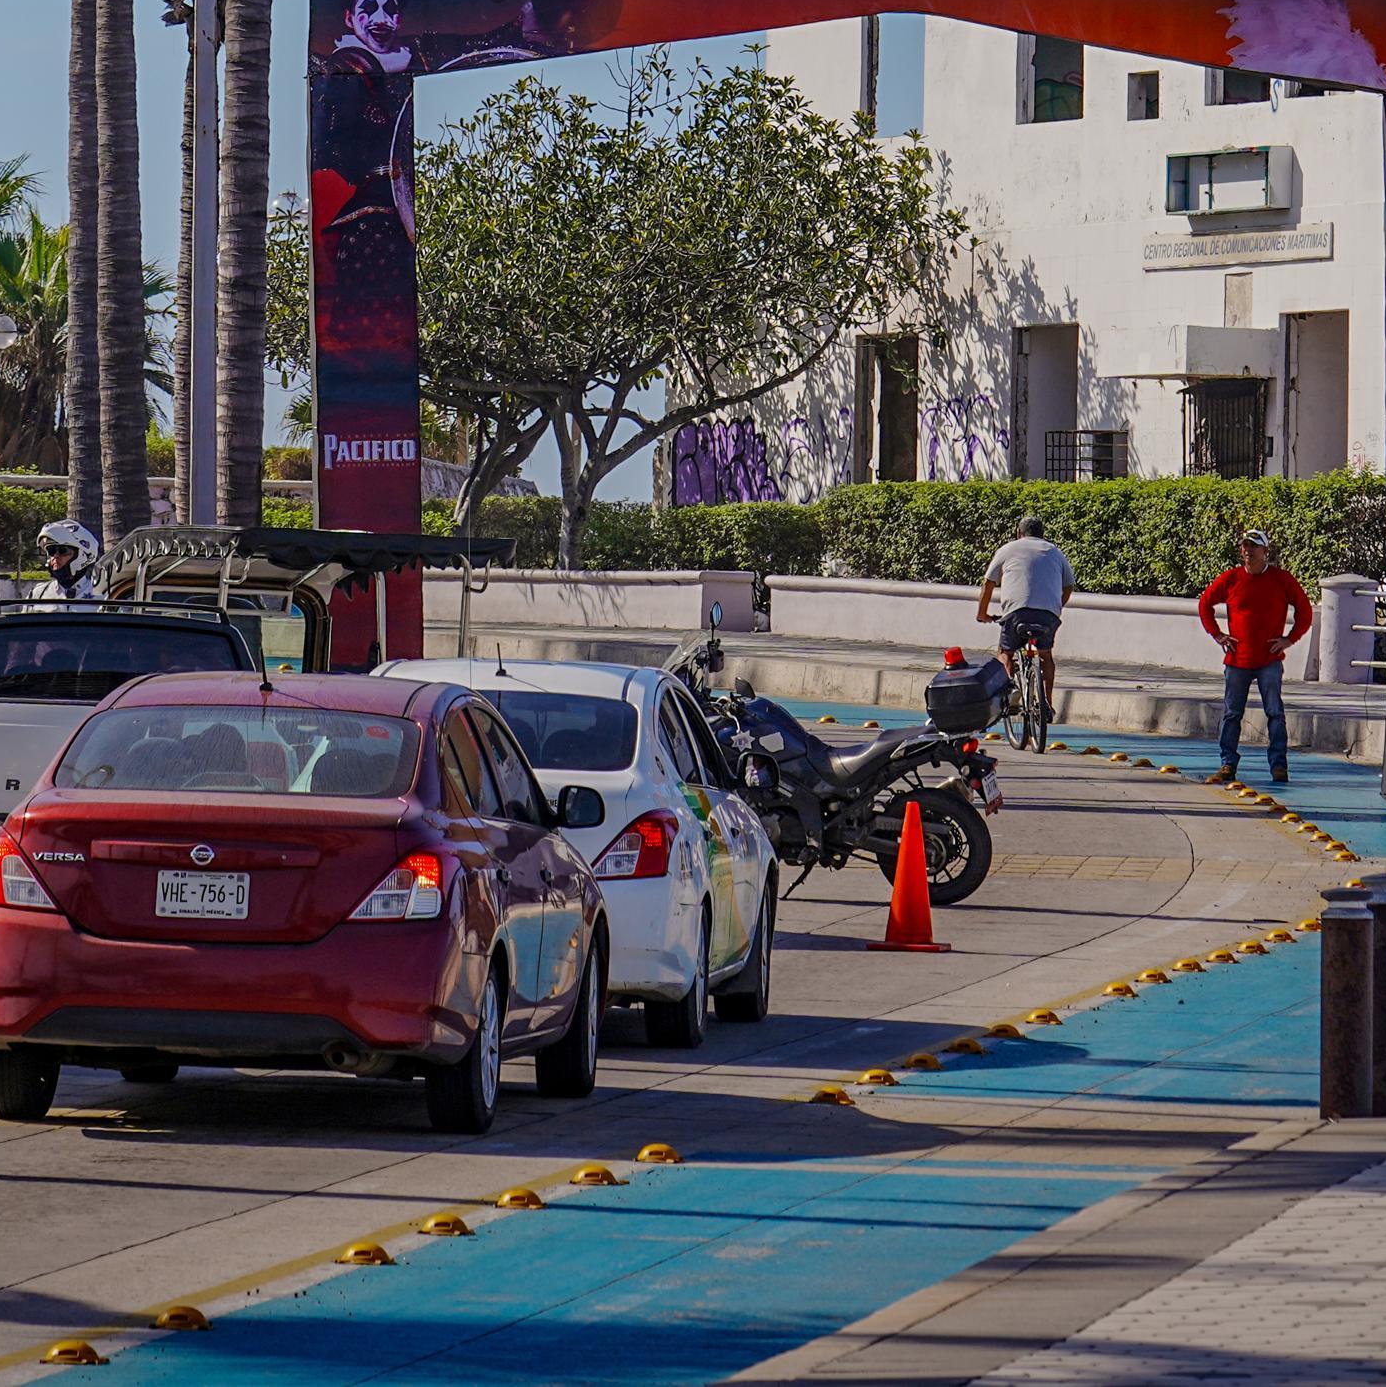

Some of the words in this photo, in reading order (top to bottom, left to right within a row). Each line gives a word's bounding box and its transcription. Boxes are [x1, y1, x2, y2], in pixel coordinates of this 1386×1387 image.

[1143, 244, 1172, 260] CENTRO
[1173, 240, 1208, 258] REGIONAL
[1210, 241, 1221, 256] DE
[1221, 235, 1286, 255] COMUNICACIONES
[1287, 232, 1329, 250] MARITIMAS
[324, 434, 417, 471] PACIFICO
[32, 852, 86, 862] VERSA
[161, 882, 245, 905] VHE-756-D
